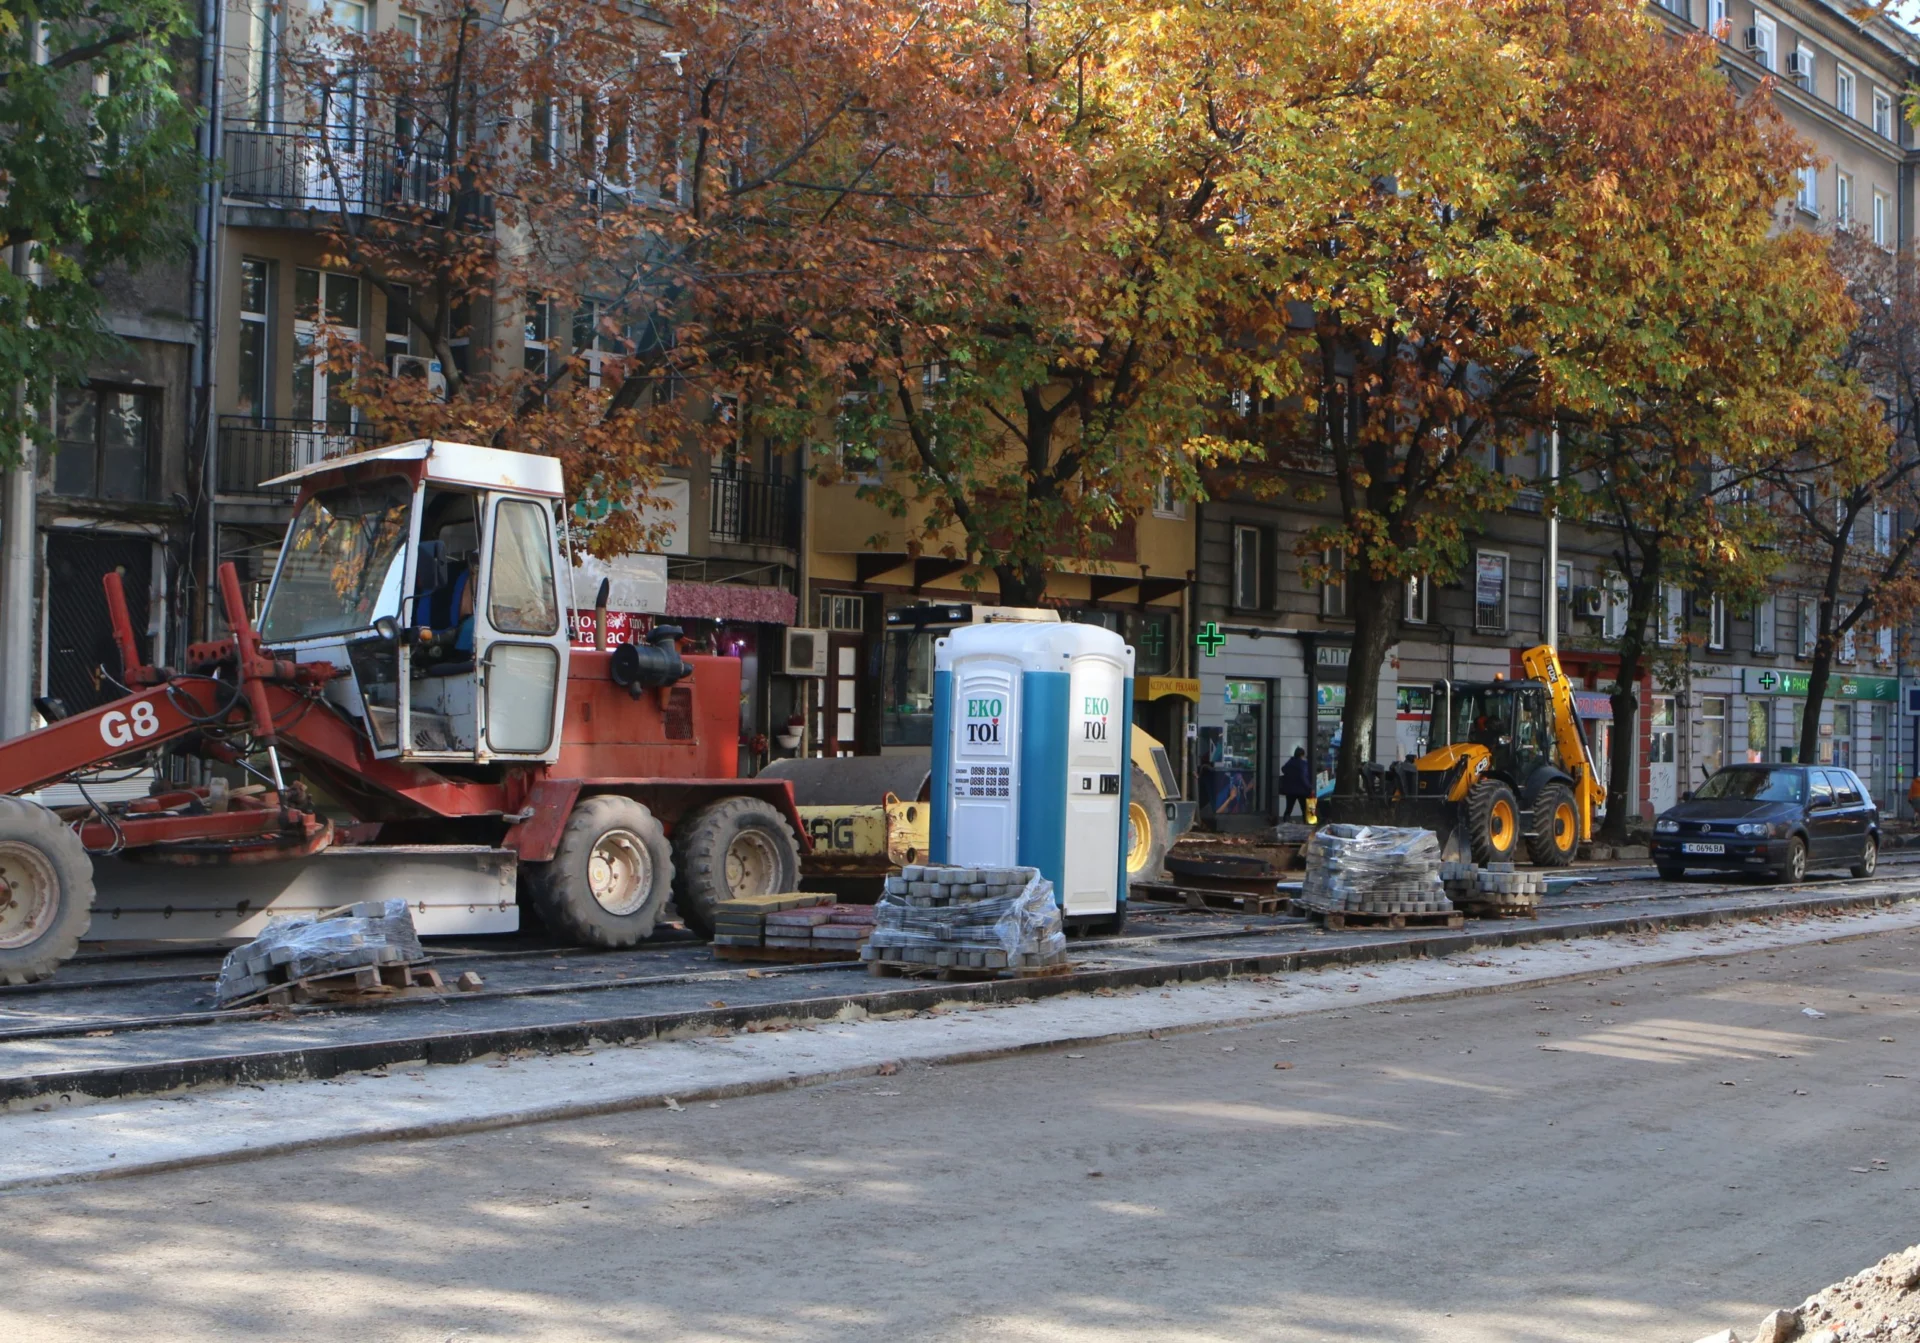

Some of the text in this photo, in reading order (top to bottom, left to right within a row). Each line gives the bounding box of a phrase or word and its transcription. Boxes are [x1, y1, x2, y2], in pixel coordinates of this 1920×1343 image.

[1318, 647, 1349, 664] АПТ
[968, 699, 1002, 718] EKO
[1084, 696, 1109, 716] EKO
[100, 700, 160, 748] G8
[970, 766, 986, 776] 0896
[1474, 756, 1489, 776] JCB
[969, 787, 985, 796] 0896
